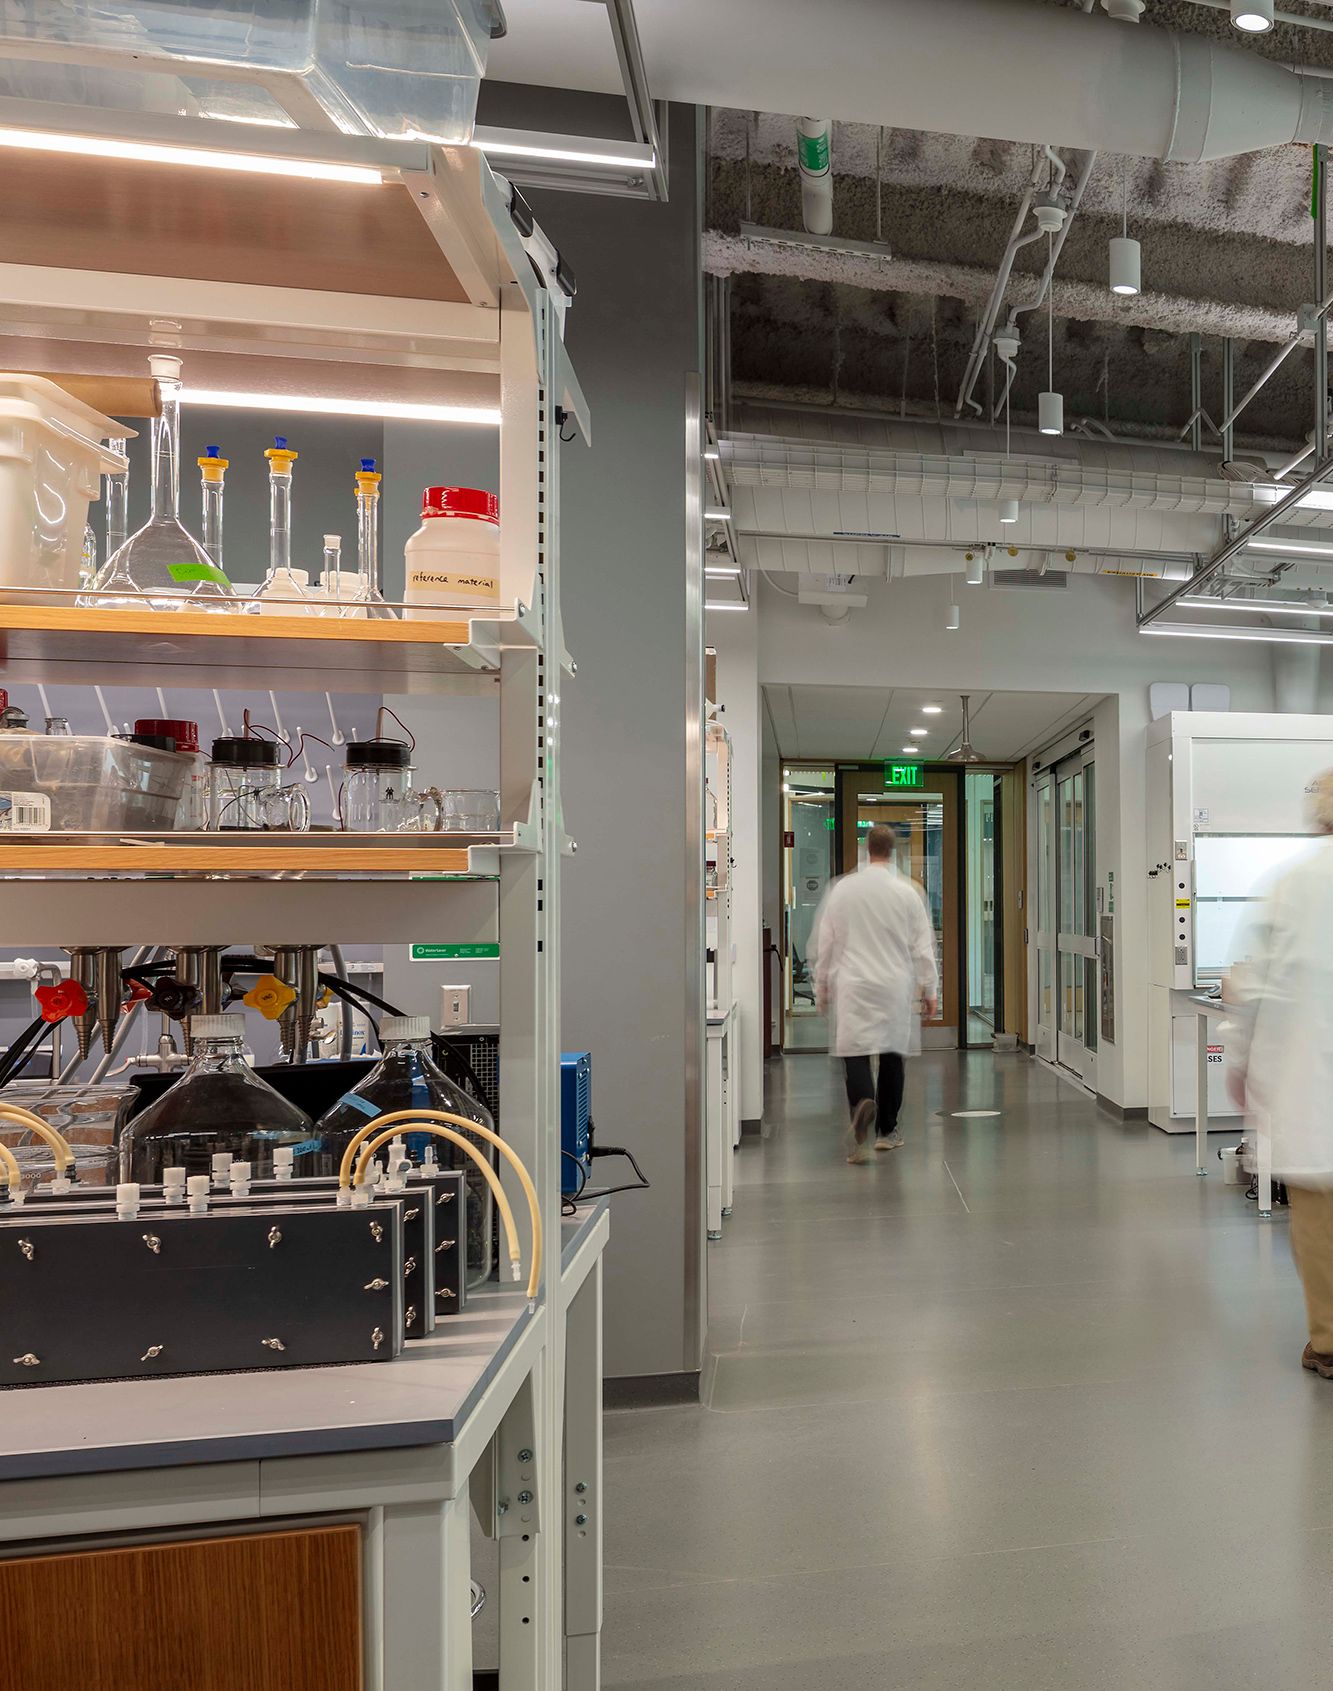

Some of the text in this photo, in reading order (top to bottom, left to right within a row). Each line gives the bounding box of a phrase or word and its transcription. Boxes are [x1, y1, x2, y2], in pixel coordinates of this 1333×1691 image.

[412, 571, 494, 589] reference material
[892, 766, 918, 785] EXIT
